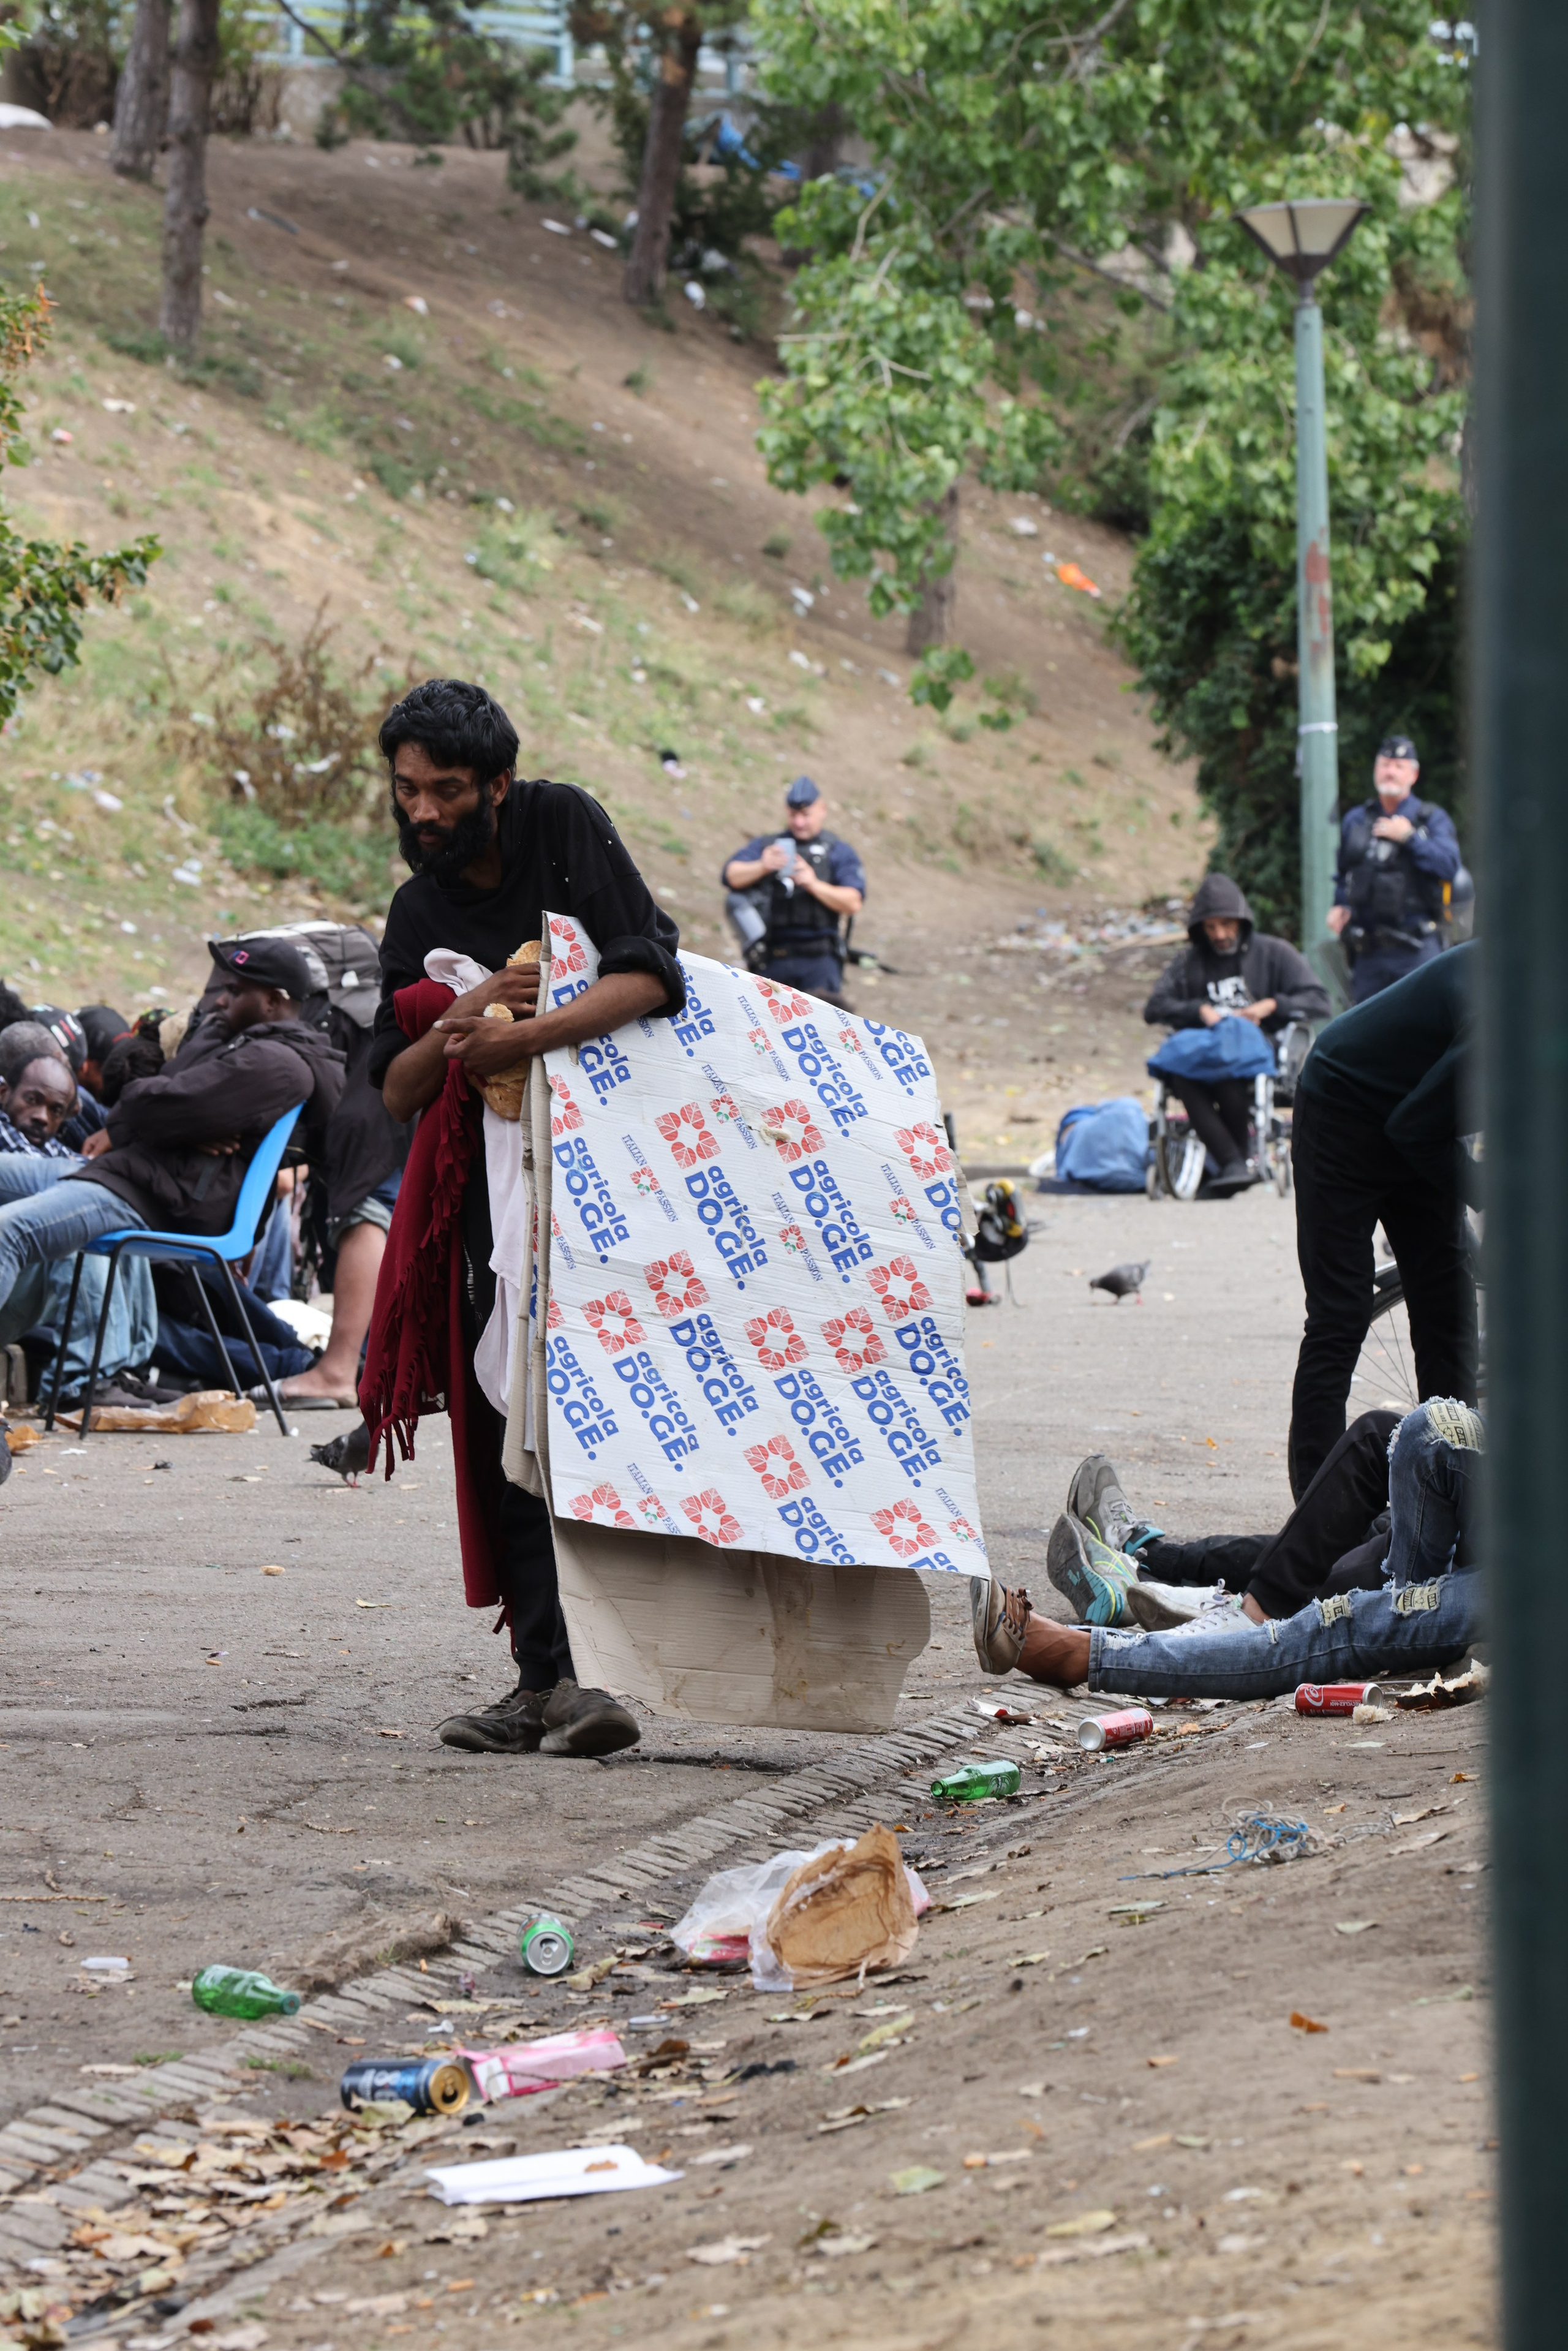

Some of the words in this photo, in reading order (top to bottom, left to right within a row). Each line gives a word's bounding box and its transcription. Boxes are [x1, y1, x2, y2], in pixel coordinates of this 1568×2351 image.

[675, 956, 715, 1035] icola
[738, 995, 761, 1027] ITALIAN
[769, 1050, 790, 1082] PASSION
[782, 1027, 856, 1138] DO.GE.
[804, 1024, 868, 1117] agricola
[859, 1051, 882, 1080] PASSION
[864, 1019, 918, 1096] O.GE.
[896, 1032, 930, 1077] cola
[702, 1065, 727, 1095] ITALIAN
[734, 1116, 756, 1149] PASSION
[553, 1141, 609, 1262] DO.GE.
[574, 1137, 630, 1246] agricola
[622, 1134, 647, 1167] ITALIAN
[654, 1188, 679, 1222] PASSION
[708, 1166, 768, 1266] agricola
[790, 1165, 859, 1283] DO.GE.
[812, 1160, 873, 1261] agricola
[881, 1164, 903, 1196] ITALIAN
[911, 1219, 935, 1250] PASSION
[925, 1182, 964, 1255] DO.
[685, 1171, 755, 1290] DO.GE.
[772, 1192, 796, 1224] ITALIAN
[801, 1248, 822, 1281] PASSION
[554, 1336, 619, 1436] agricola
[637, 1352, 699, 1451] agricola
[669, 1318, 744, 1436] DO.GE.
[697, 1313, 759, 1413] agricola
[895, 1323, 970, 1436] DO.GE.
[921, 1317, 970, 1405] agrico
[612, 1356, 688, 1472] DO.GE.
[774, 1373, 851, 1488] DO.GE.
[799, 1370, 864, 1464] agricola
[851, 1376, 928, 1487] DO.GE.
[875, 1370, 941, 1465] agricola
[627, 1462, 654, 1495] ITALIAN
[936, 1488, 962, 1517] ITALIAN
[778, 1501, 834, 1564] DO.
[801, 1497, 856, 1564] agrico
